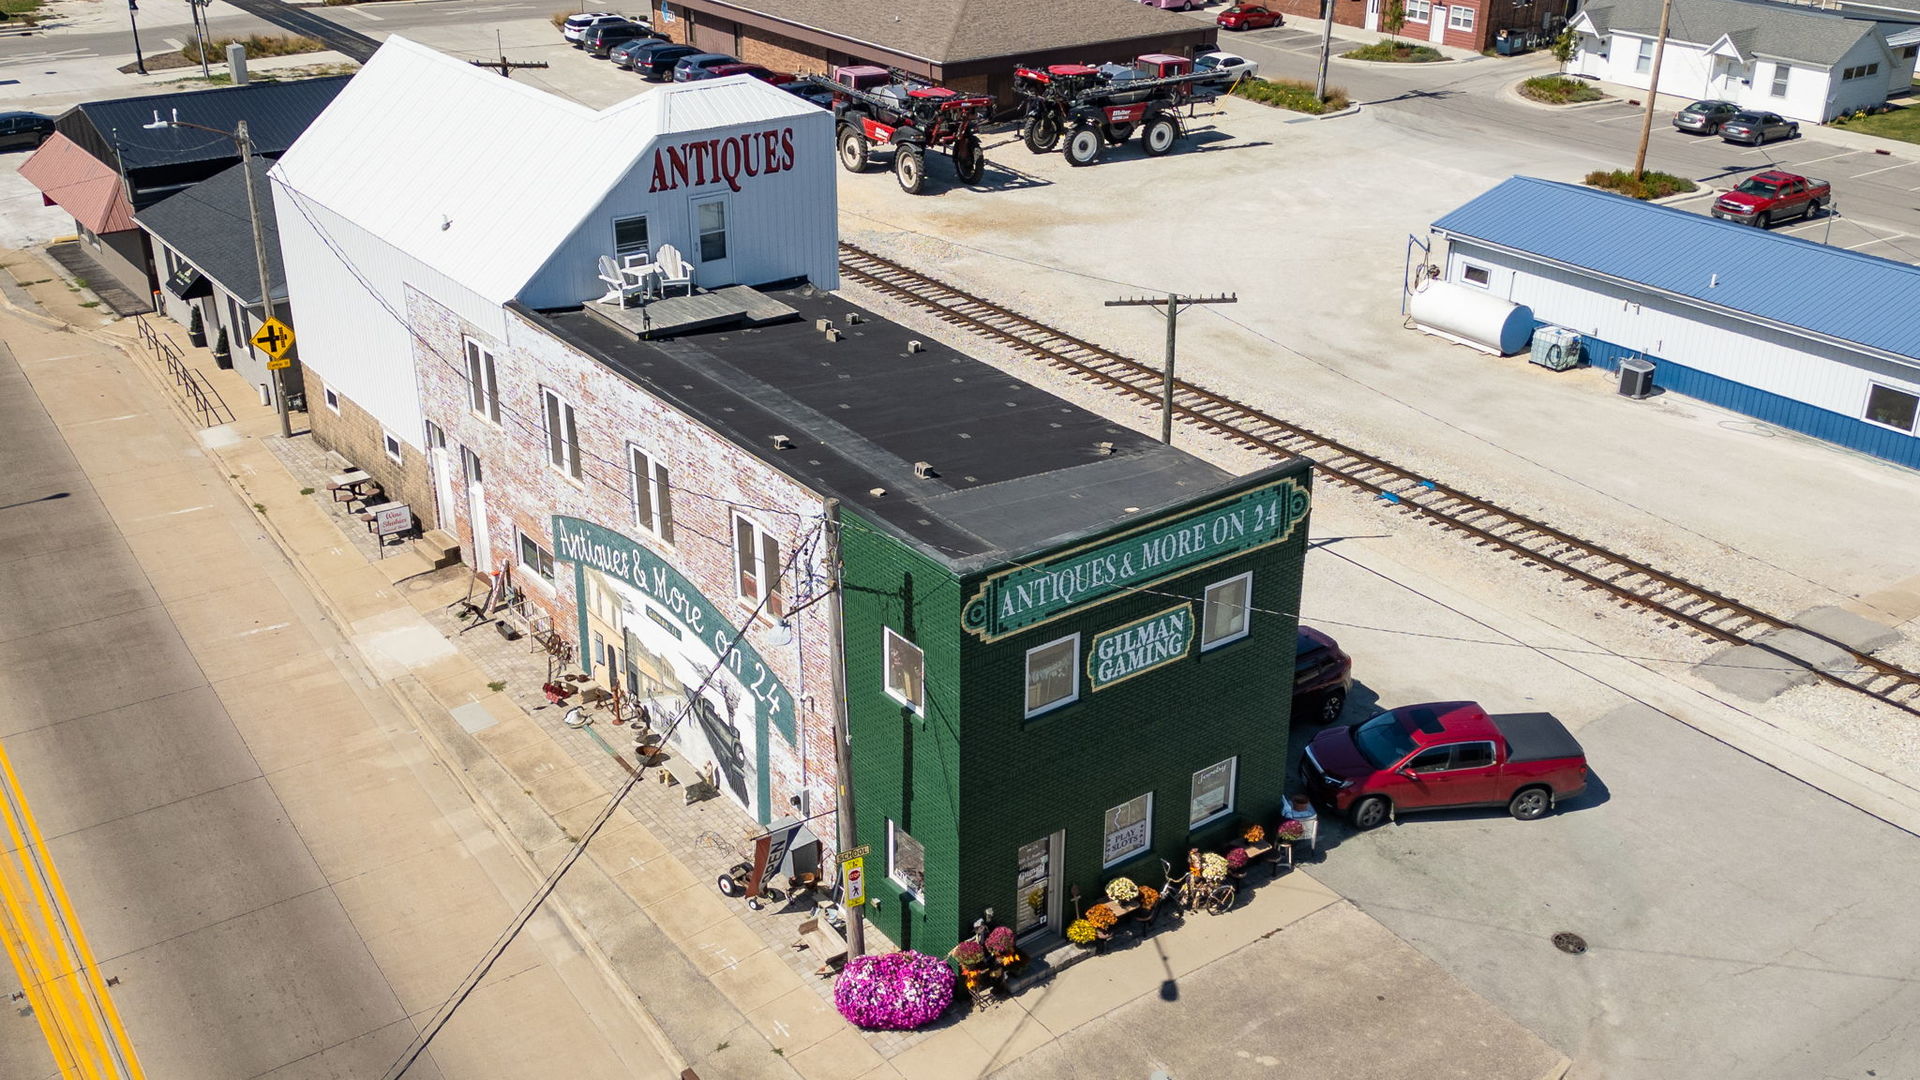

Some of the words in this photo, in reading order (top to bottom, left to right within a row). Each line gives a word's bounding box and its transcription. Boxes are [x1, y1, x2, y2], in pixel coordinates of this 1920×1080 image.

[649, 127, 795, 192] ANTIQUES
[1000, 554, 1116, 619] ANTIQUES
[1119, 552, 1136, 578] &
[1140, 522, 1206, 572] MORE
[1212, 509, 1246, 545] ON
[1253, 500, 1279, 532] 24
[559, 518, 630, 580] Antiques
[632, 549, 650, 593] &
[654, 567, 704, 633] More
[750, 664, 781, 715] 24
[1098, 611, 1186, 660] GILMAN
[1098, 633, 1183, 682] GAMING
[838, 846, 868, 860] SCHOOL
[1111, 835, 1139, 852] SLOTS
[1114, 829, 1136, 843] PLAY
